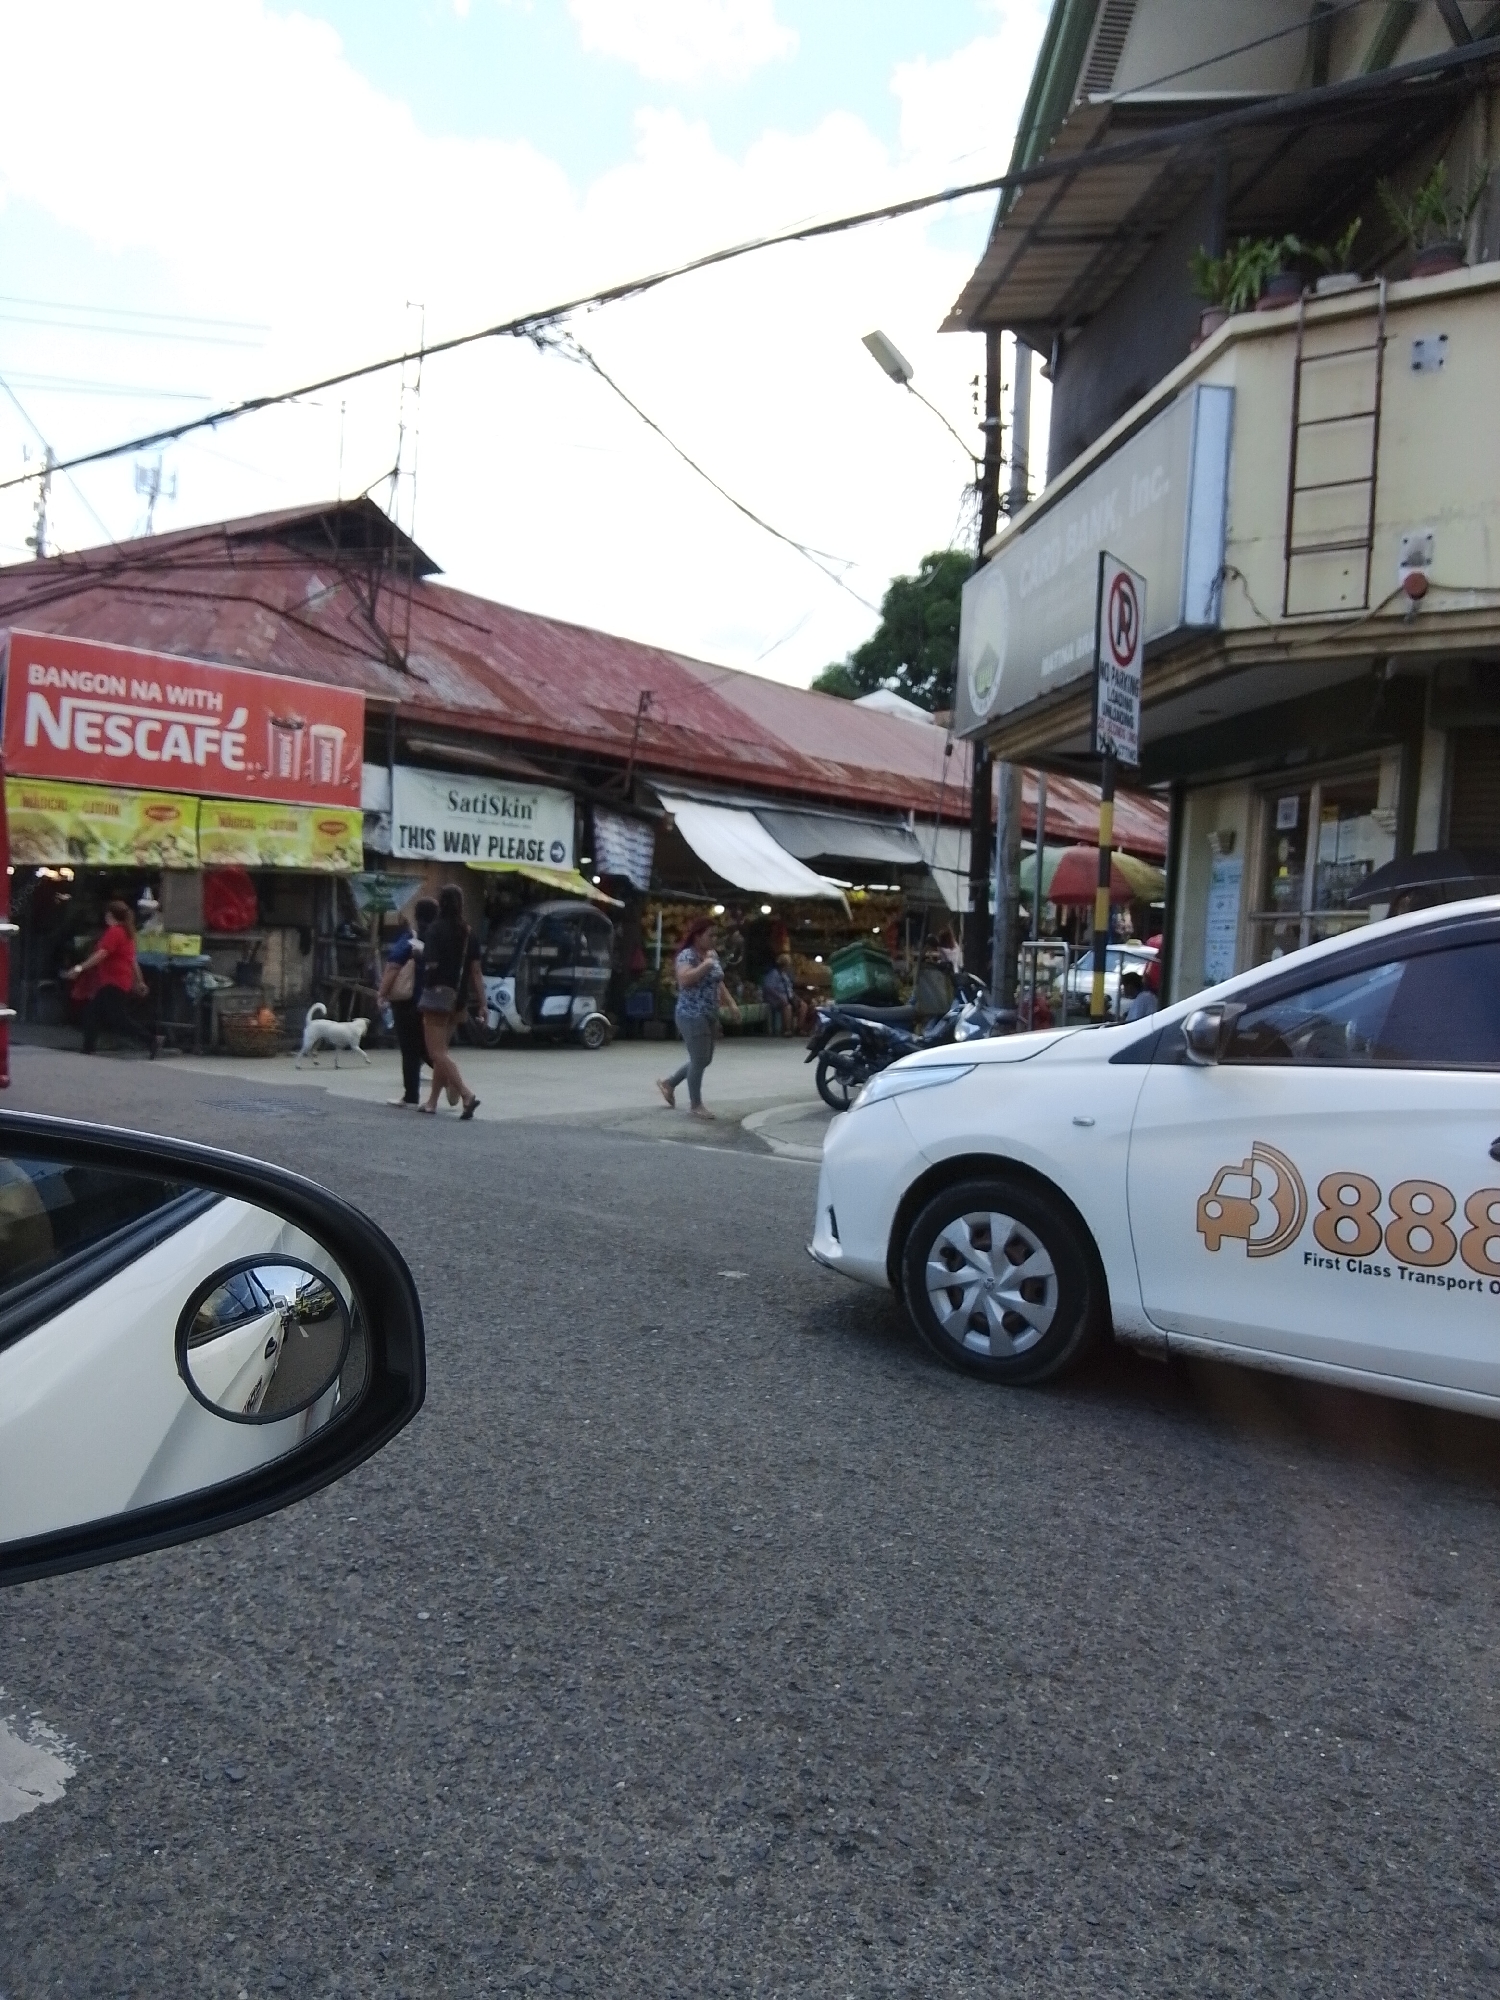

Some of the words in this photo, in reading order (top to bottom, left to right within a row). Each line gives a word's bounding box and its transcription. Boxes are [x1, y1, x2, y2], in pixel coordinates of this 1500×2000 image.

[28, 663, 127, 697] BANGON
[130, 679, 163, 702] NA
[166, 684, 224, 712] WITH
[399, 824, 437, 851] THIS
[444, 829, 481, 856] WAY
[488, 835, 545, 862] PLEASE
[1303, 1252, 1341, 1272] First
[1346, 1259, 1391, 1278] Class
[1398, 1266, 1483, 1293] Transport
